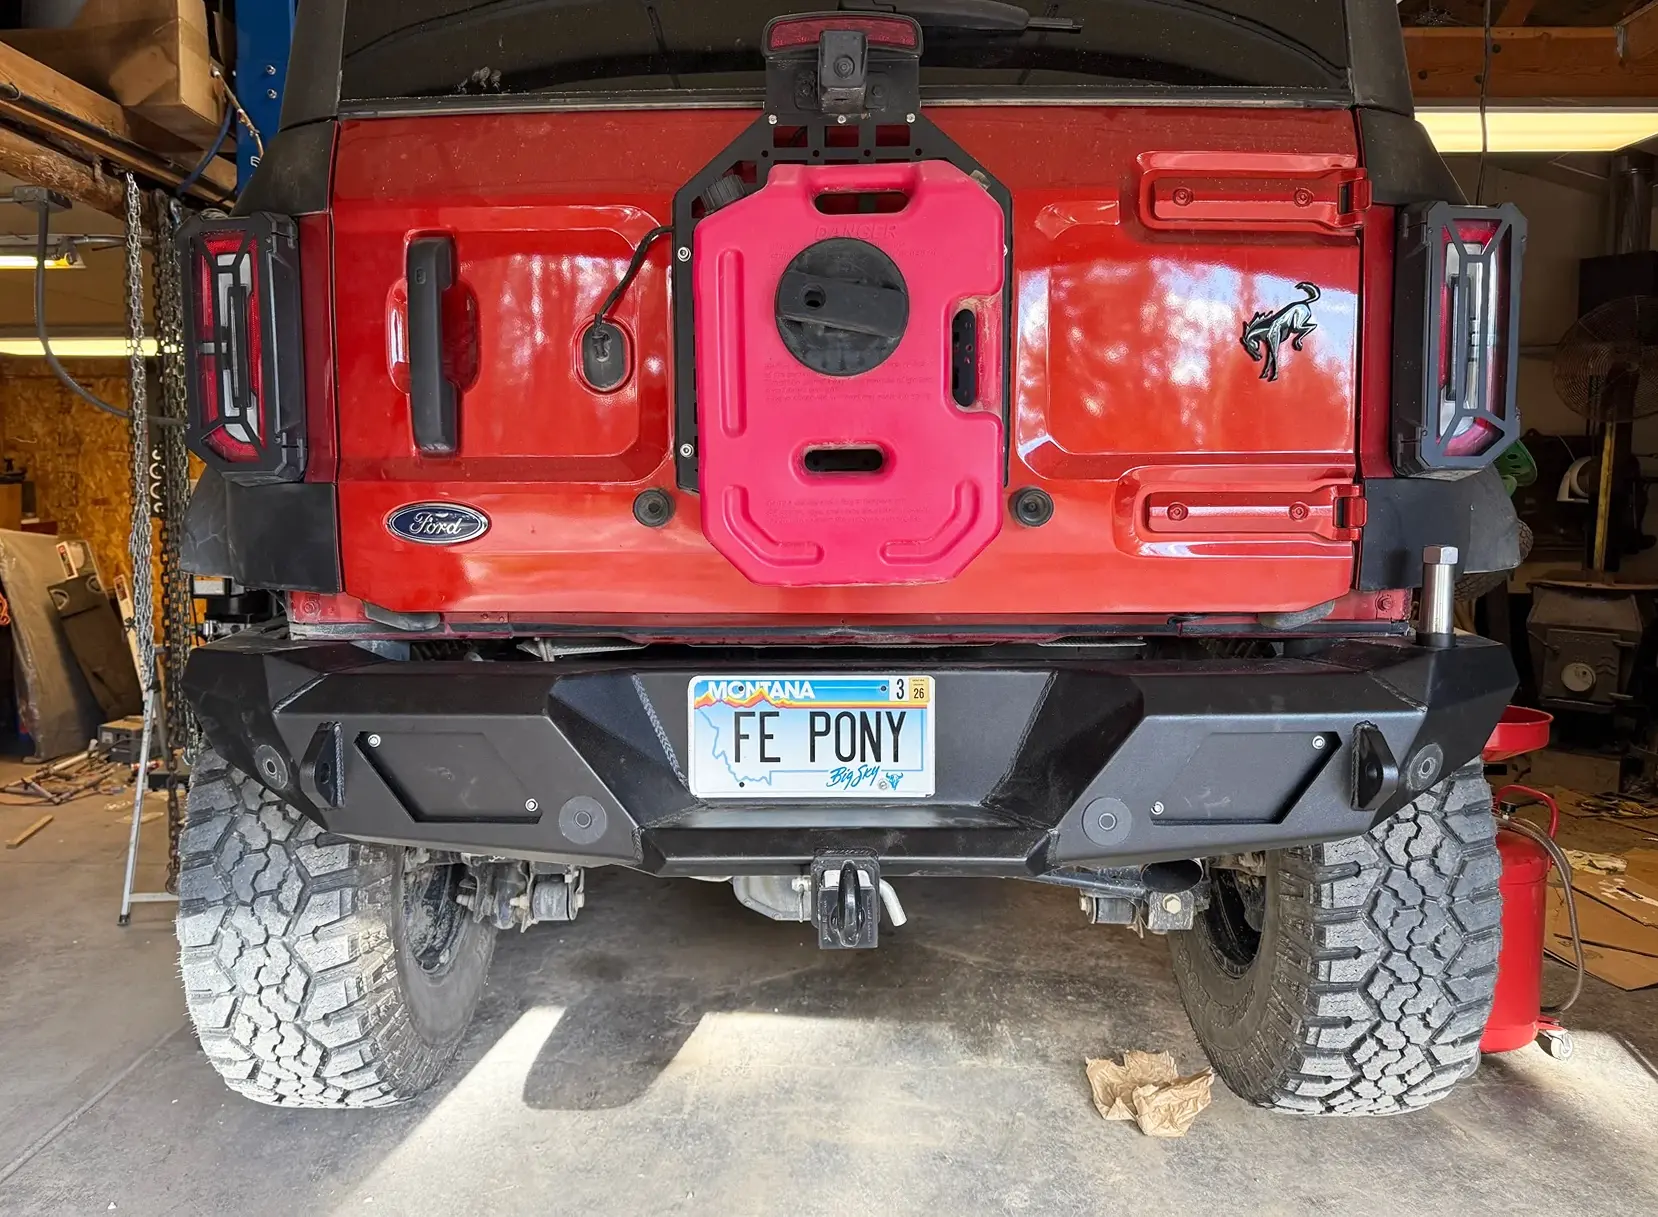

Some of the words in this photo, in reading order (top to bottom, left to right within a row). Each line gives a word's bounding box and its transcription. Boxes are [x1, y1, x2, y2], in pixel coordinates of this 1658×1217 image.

[815, 223, 897, 240] DANGER
[409, 512, 461, 534] Ford
[708, 680, 816, 700] MONTANA
[896, 678, 905, 700] 3
[913, 687, 925, 699] 26
[734, 711, 781, 763] FE
[809, 711, 907, 763] PONY
[826, 766, 853, 790] Big
[851, 764, 880, 787] Sky
